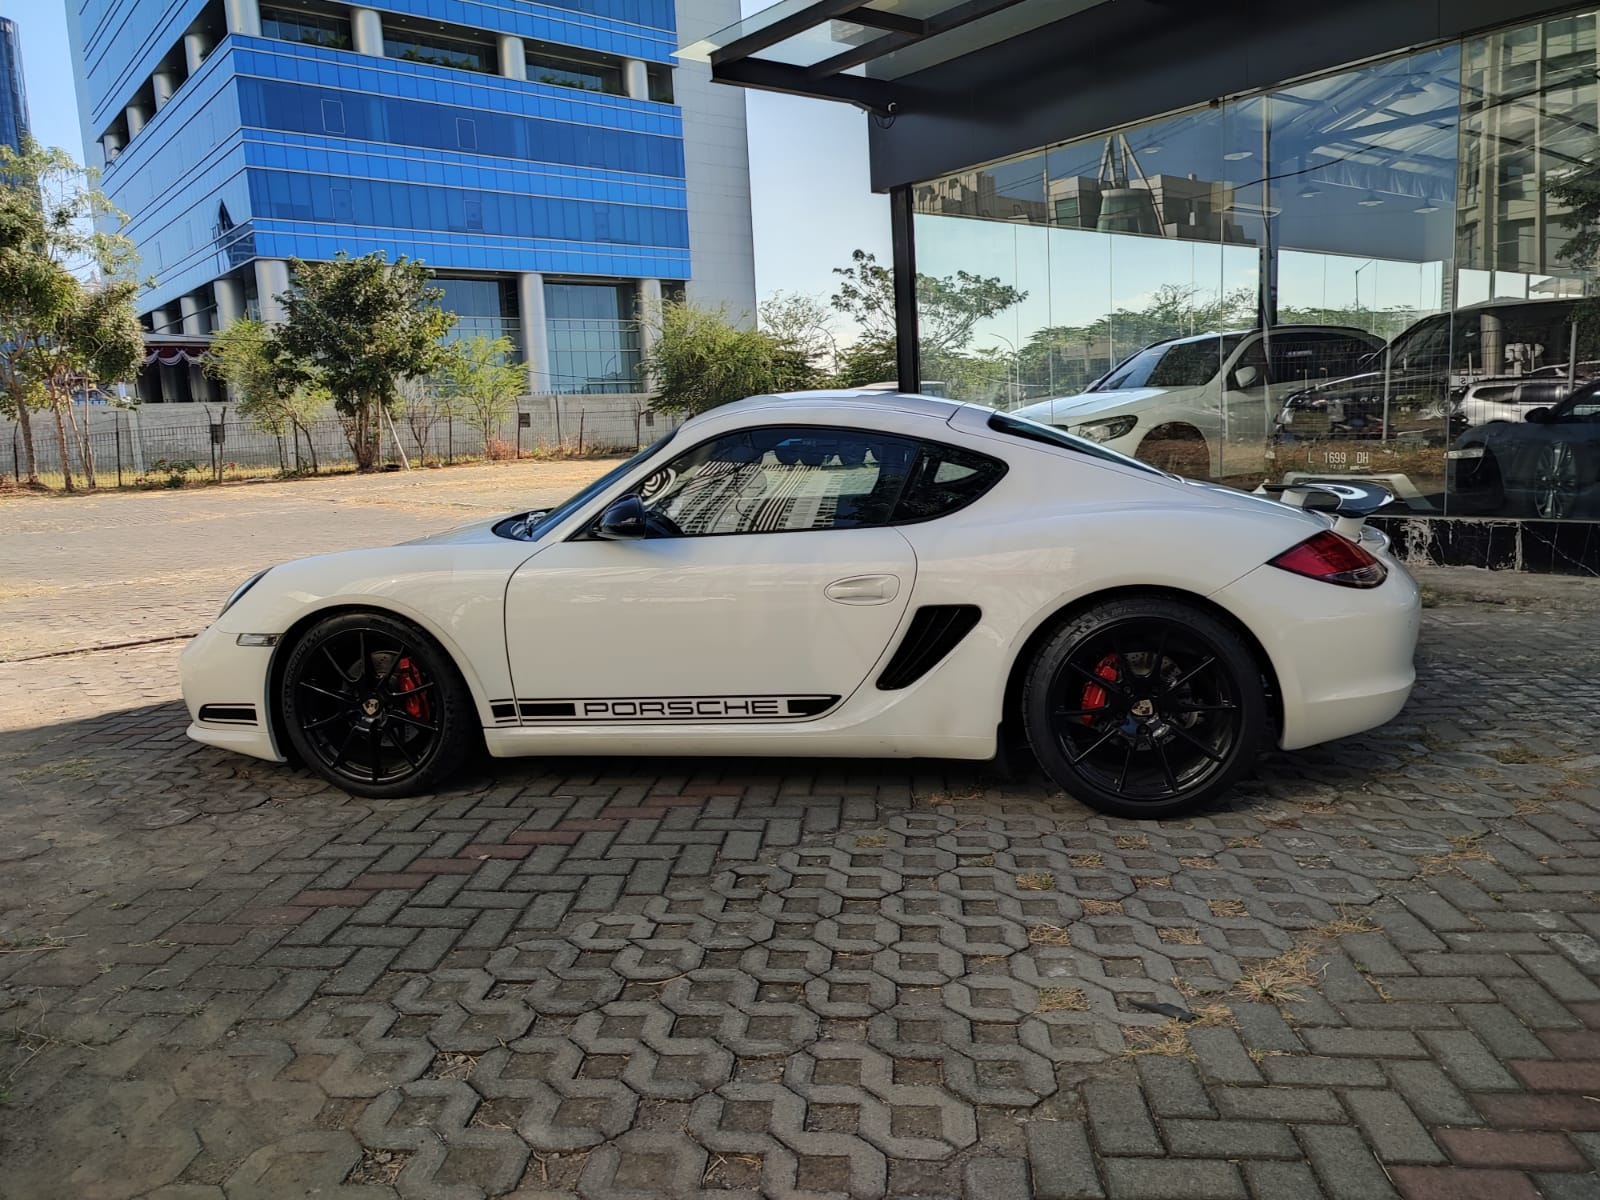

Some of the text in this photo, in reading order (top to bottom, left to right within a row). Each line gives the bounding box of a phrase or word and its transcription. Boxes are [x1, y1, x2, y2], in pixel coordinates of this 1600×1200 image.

[1308, 451, 1369, 464] L 1699 DH
[584, 700, 779, 716] PORSCHE
